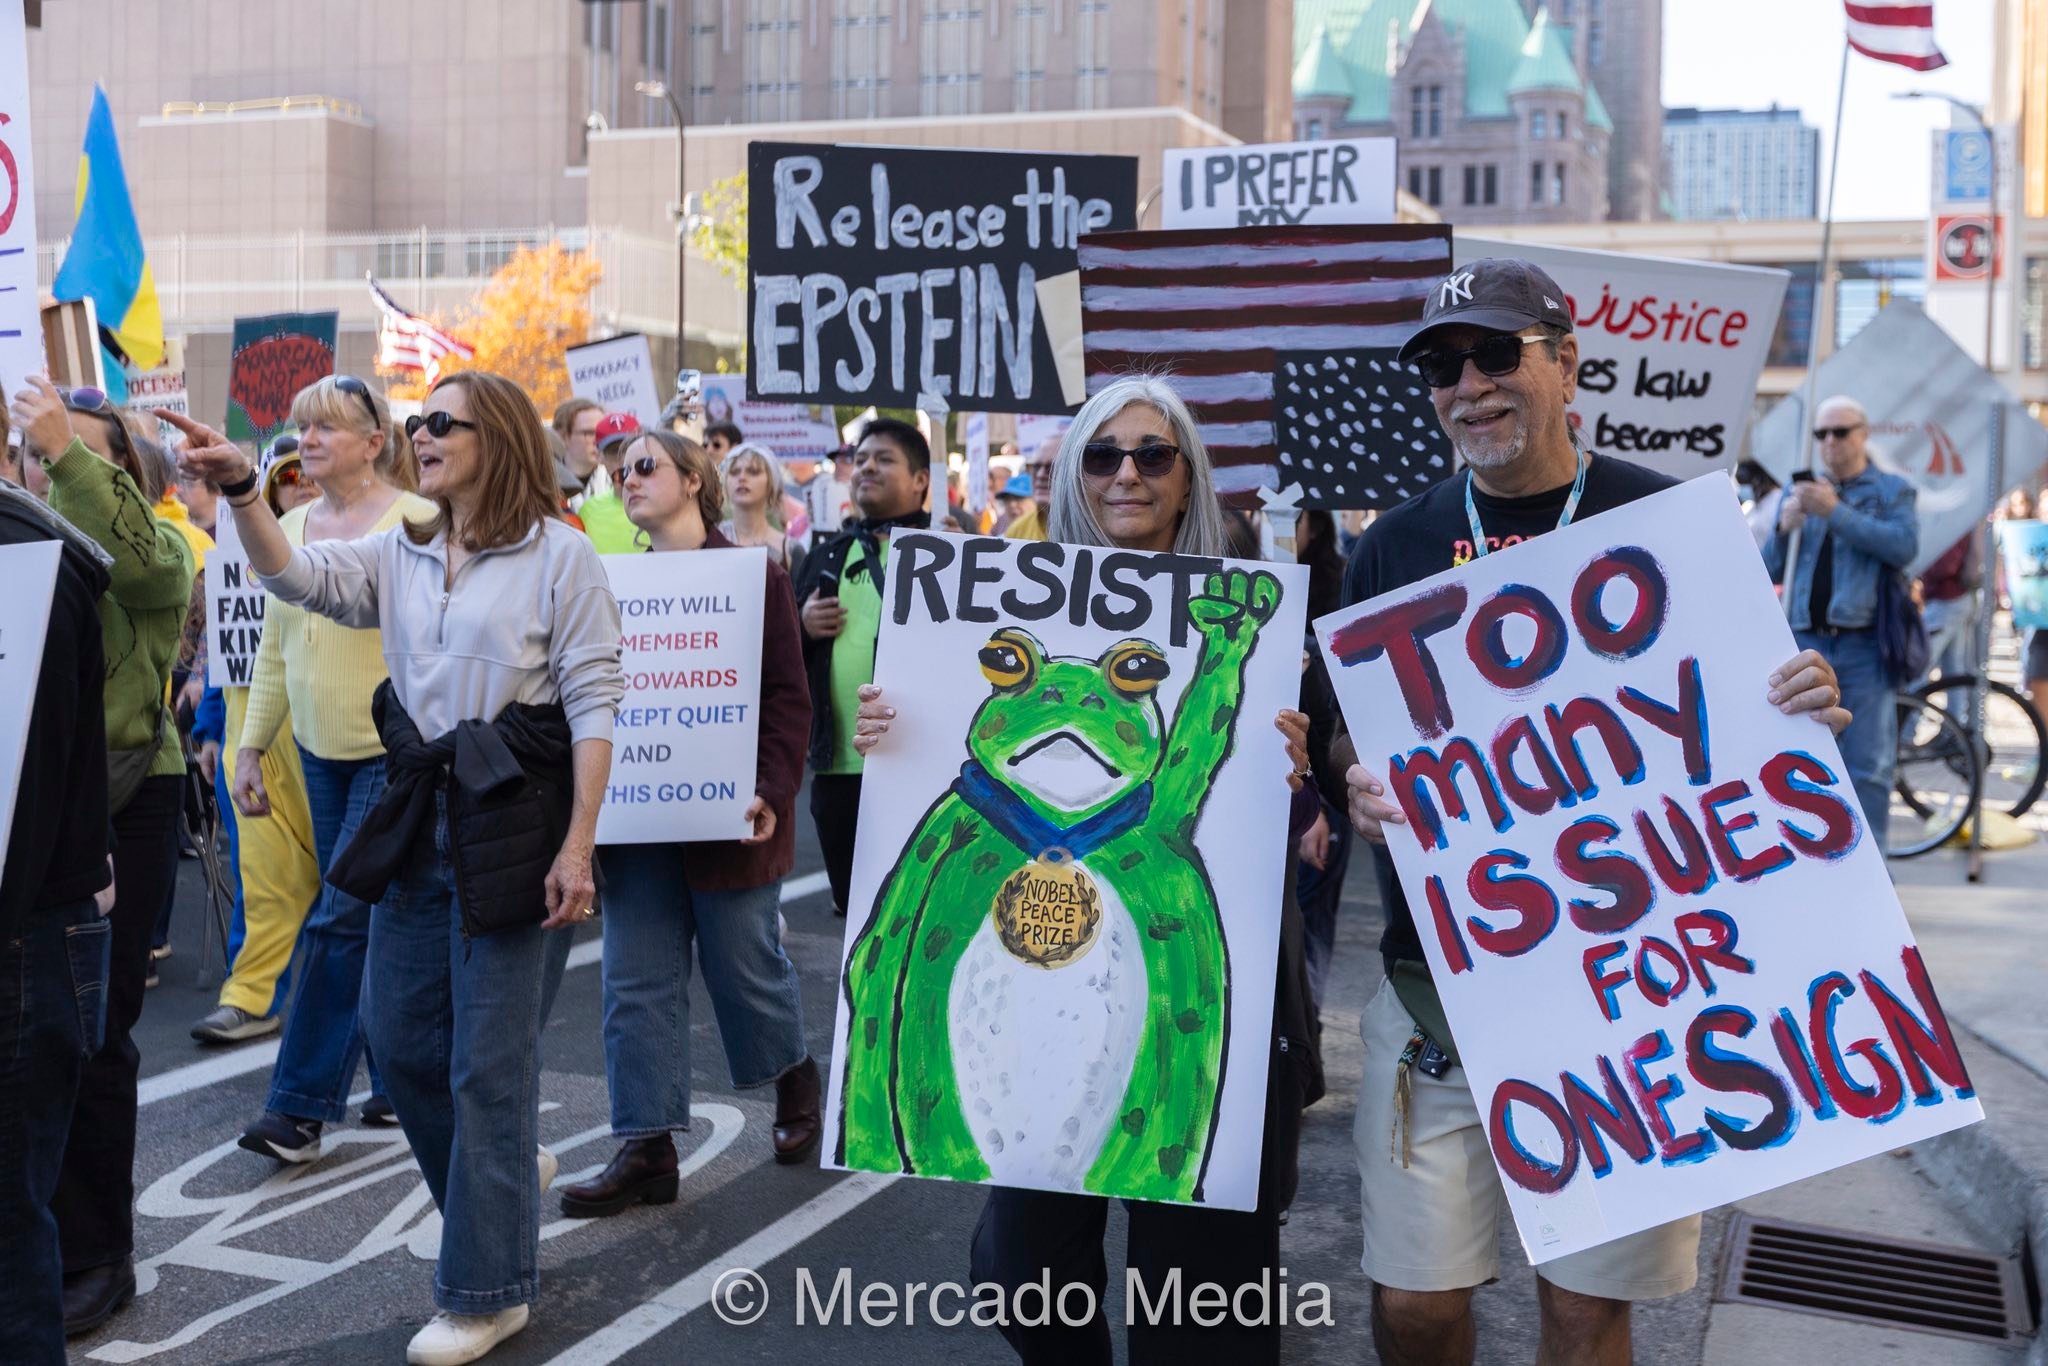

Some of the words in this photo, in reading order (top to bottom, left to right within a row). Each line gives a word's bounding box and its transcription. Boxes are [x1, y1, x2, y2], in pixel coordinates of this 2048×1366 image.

[1181, 159, 1193, 211] I
[1205, 144, 1358, 208] PREFER
[773, 155, 1007, 250] Release
[1012, 166, 1112, 250] the
[754, 261, 1036, 400] EPSTEIN
[1634, 356, 1711, 401] law
[1595, 412, 1725, 457] becomes
[893, 534, 1224, 648] RESIST
[217, 594, 264, 624] FAU
[618, 597, 675, 617] TORY
[681, 595, 737, 614] WILL
[219, 627, 262, 656] KIN
[618, 631, 719, 652] MEMBER
[1328, 543, 1671, 740] TOO
[623, 669, 738, 691] COWARDS
[614, 707, 672, 727] KEPT
[677, 705, 749, 729] QUIET
[620, 744, 672, 764] AND
[657, 782, 693, 802] GO
[700, 781, 736, 801] ON
[1425, 749, 1863, 975] ISSUES
[1024, 879, 1080, 905] NOBEL
[1020, 900, 1075, 924] PEACE
[1021, 922, 1073, 946] PRIZE
[1581, 908, 1756, 1023] FOR
